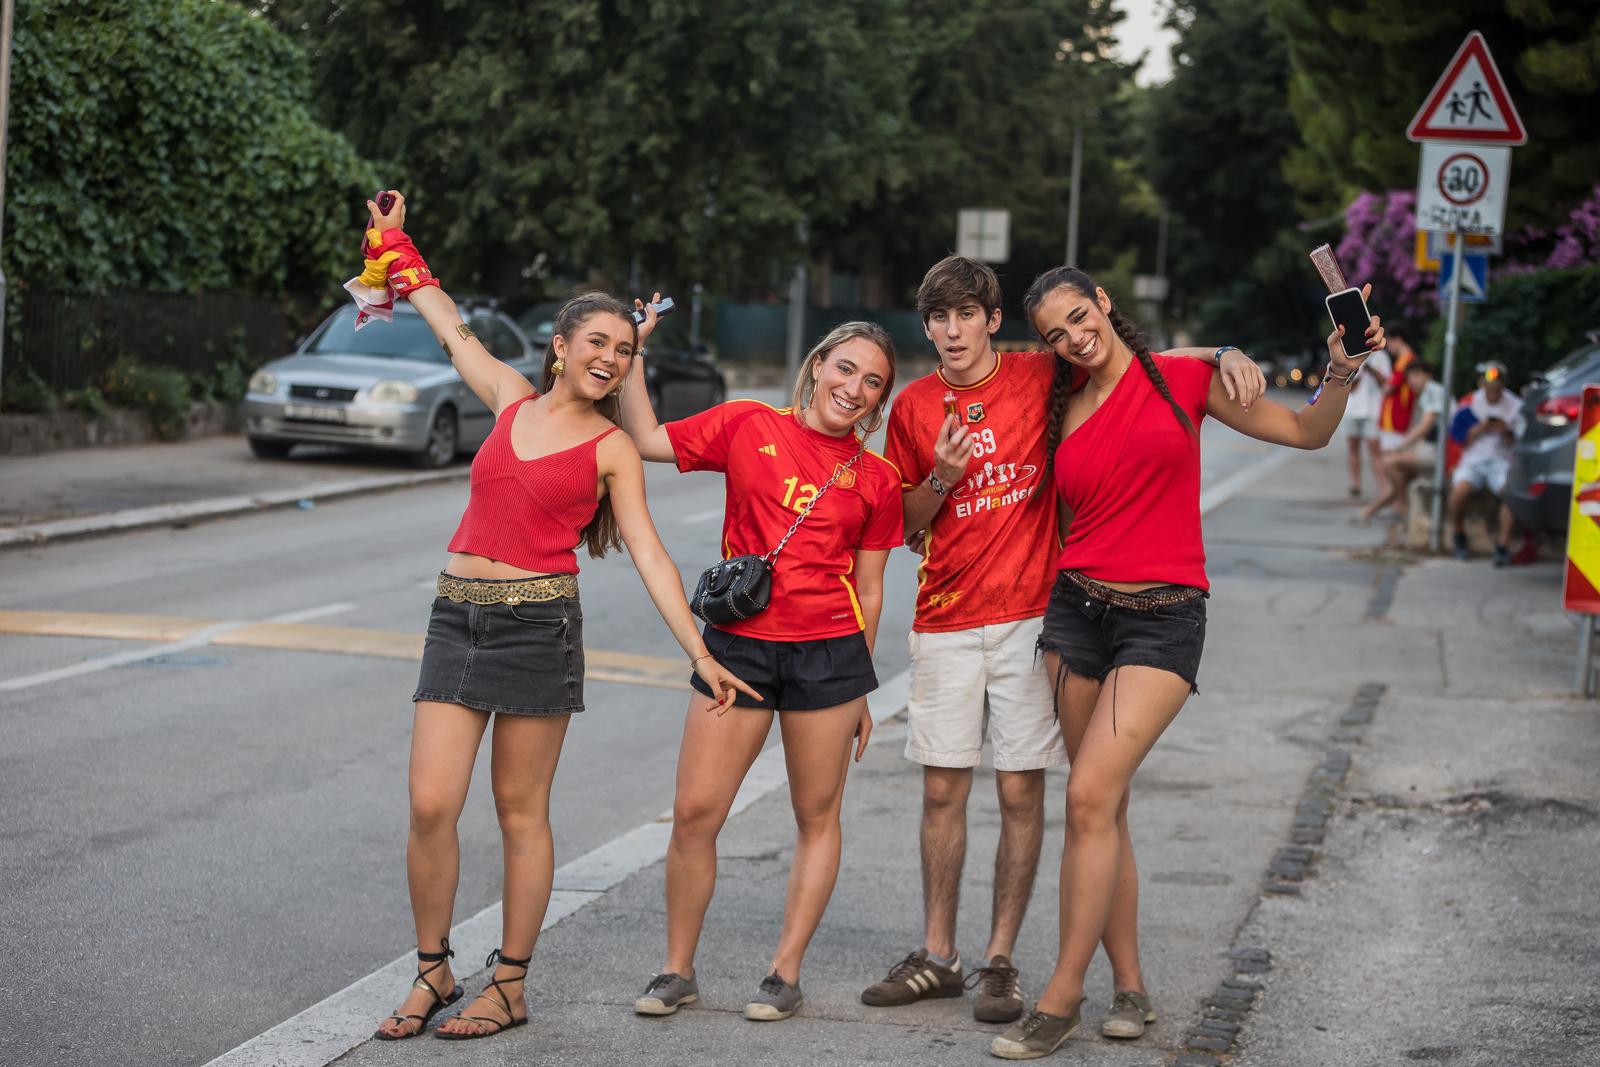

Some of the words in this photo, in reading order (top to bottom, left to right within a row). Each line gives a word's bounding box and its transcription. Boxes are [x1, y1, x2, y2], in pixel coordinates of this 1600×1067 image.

[1448, 165, 1479, 192] 30
[970, 428, 997, 458] 69
[782, 475, 819, 516] 12
[956, 502, 971, 518] El
